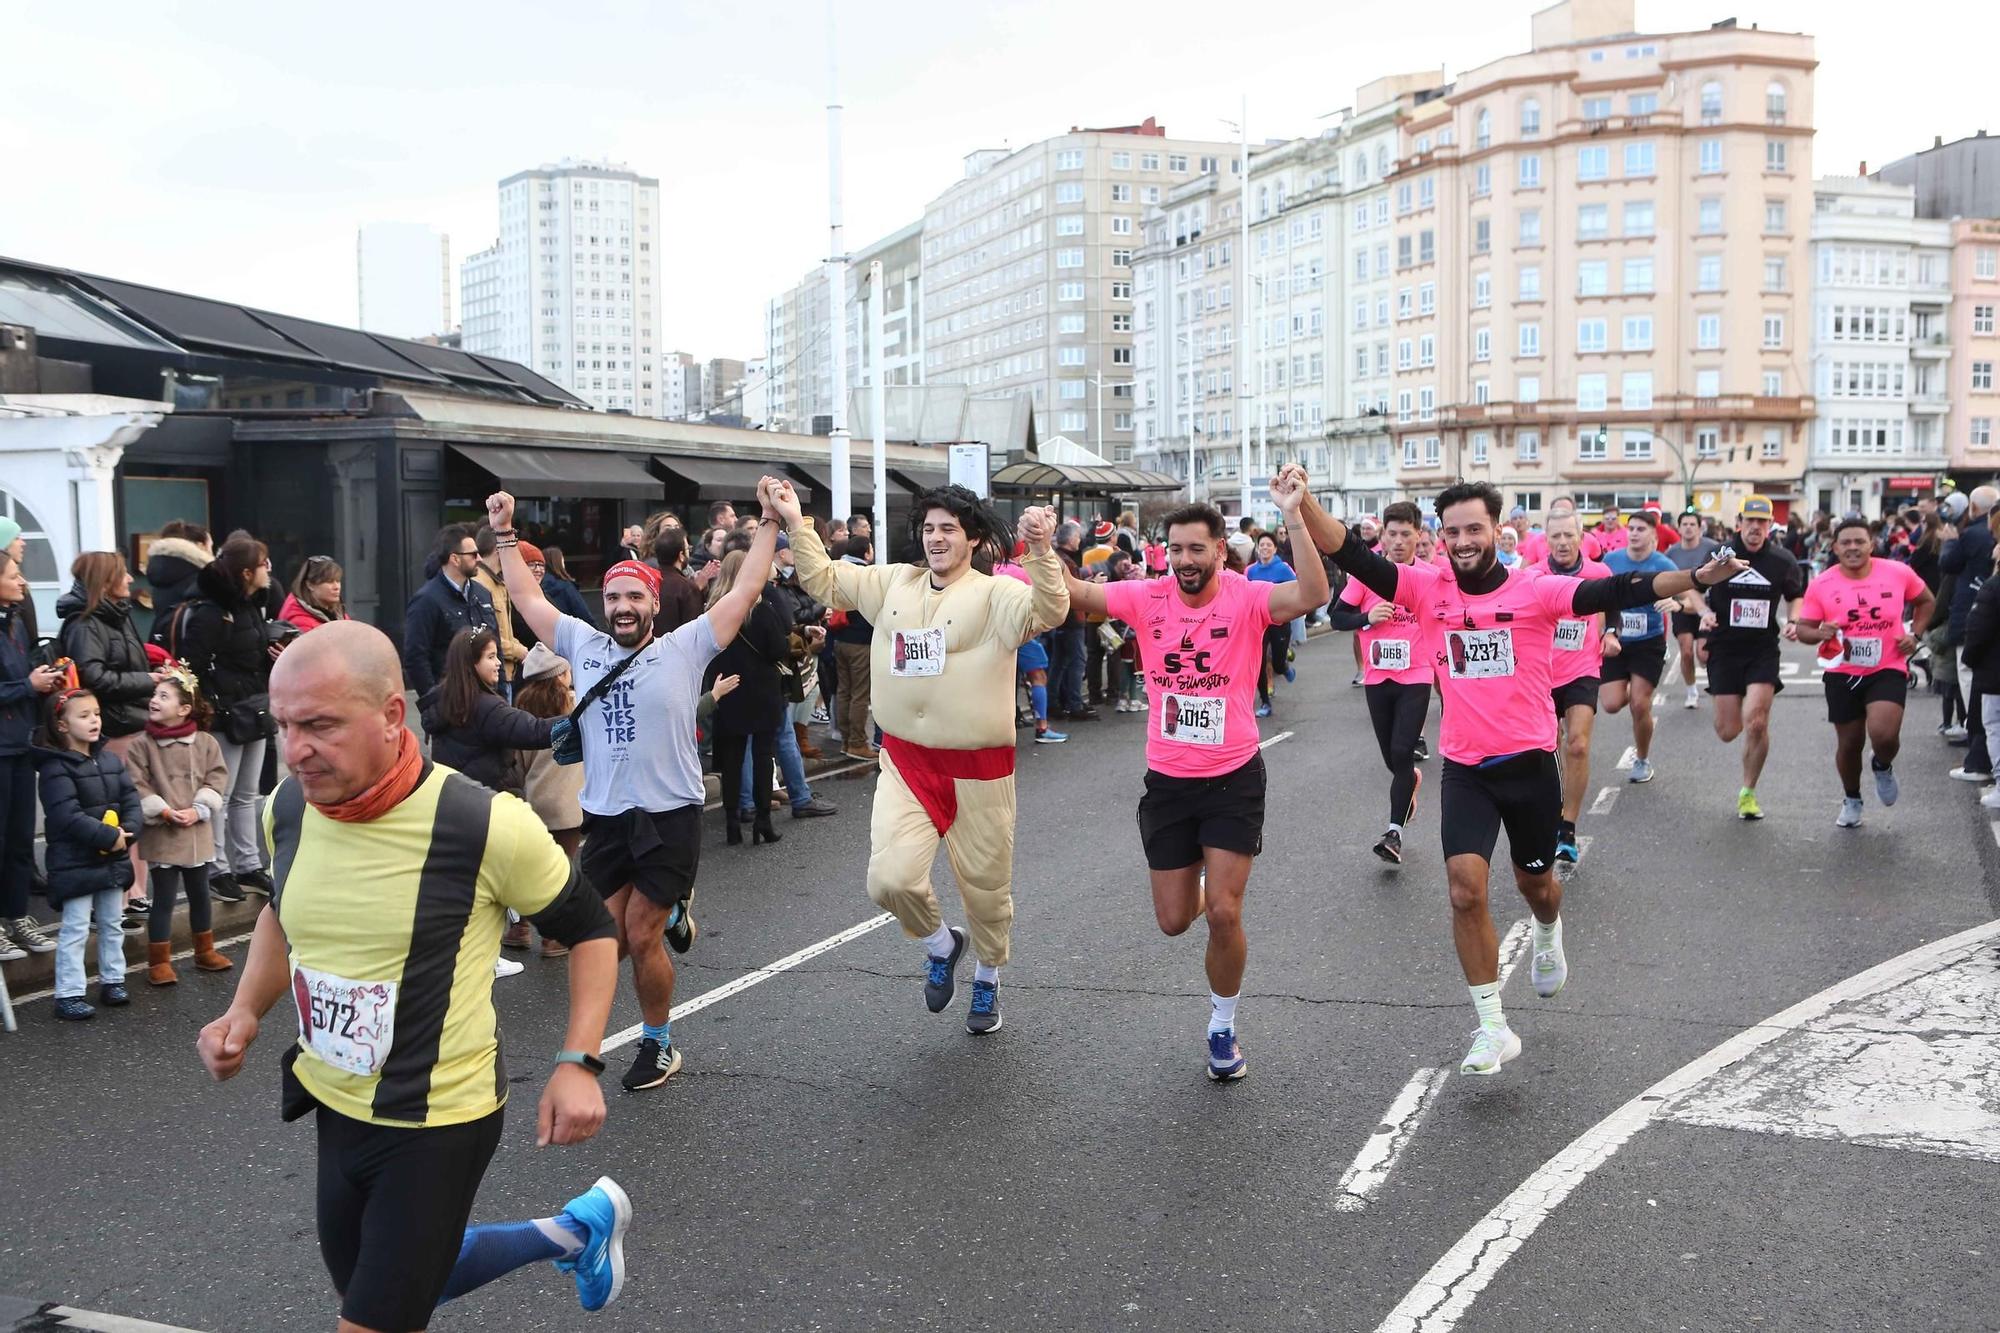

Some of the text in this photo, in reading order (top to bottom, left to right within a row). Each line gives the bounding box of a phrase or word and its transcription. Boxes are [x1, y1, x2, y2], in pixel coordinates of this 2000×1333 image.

[611, 679, 635, 692] AN
[1150, 671, 1230, 690] San Silvestre
[600, 692, 635, 711] SIL
[602, 709, 636, 727] VES
[1177, 708, 1210, 728] 4015
[605, 726, 636, 744] TRE
[310, 996, 356, 1039] 572
